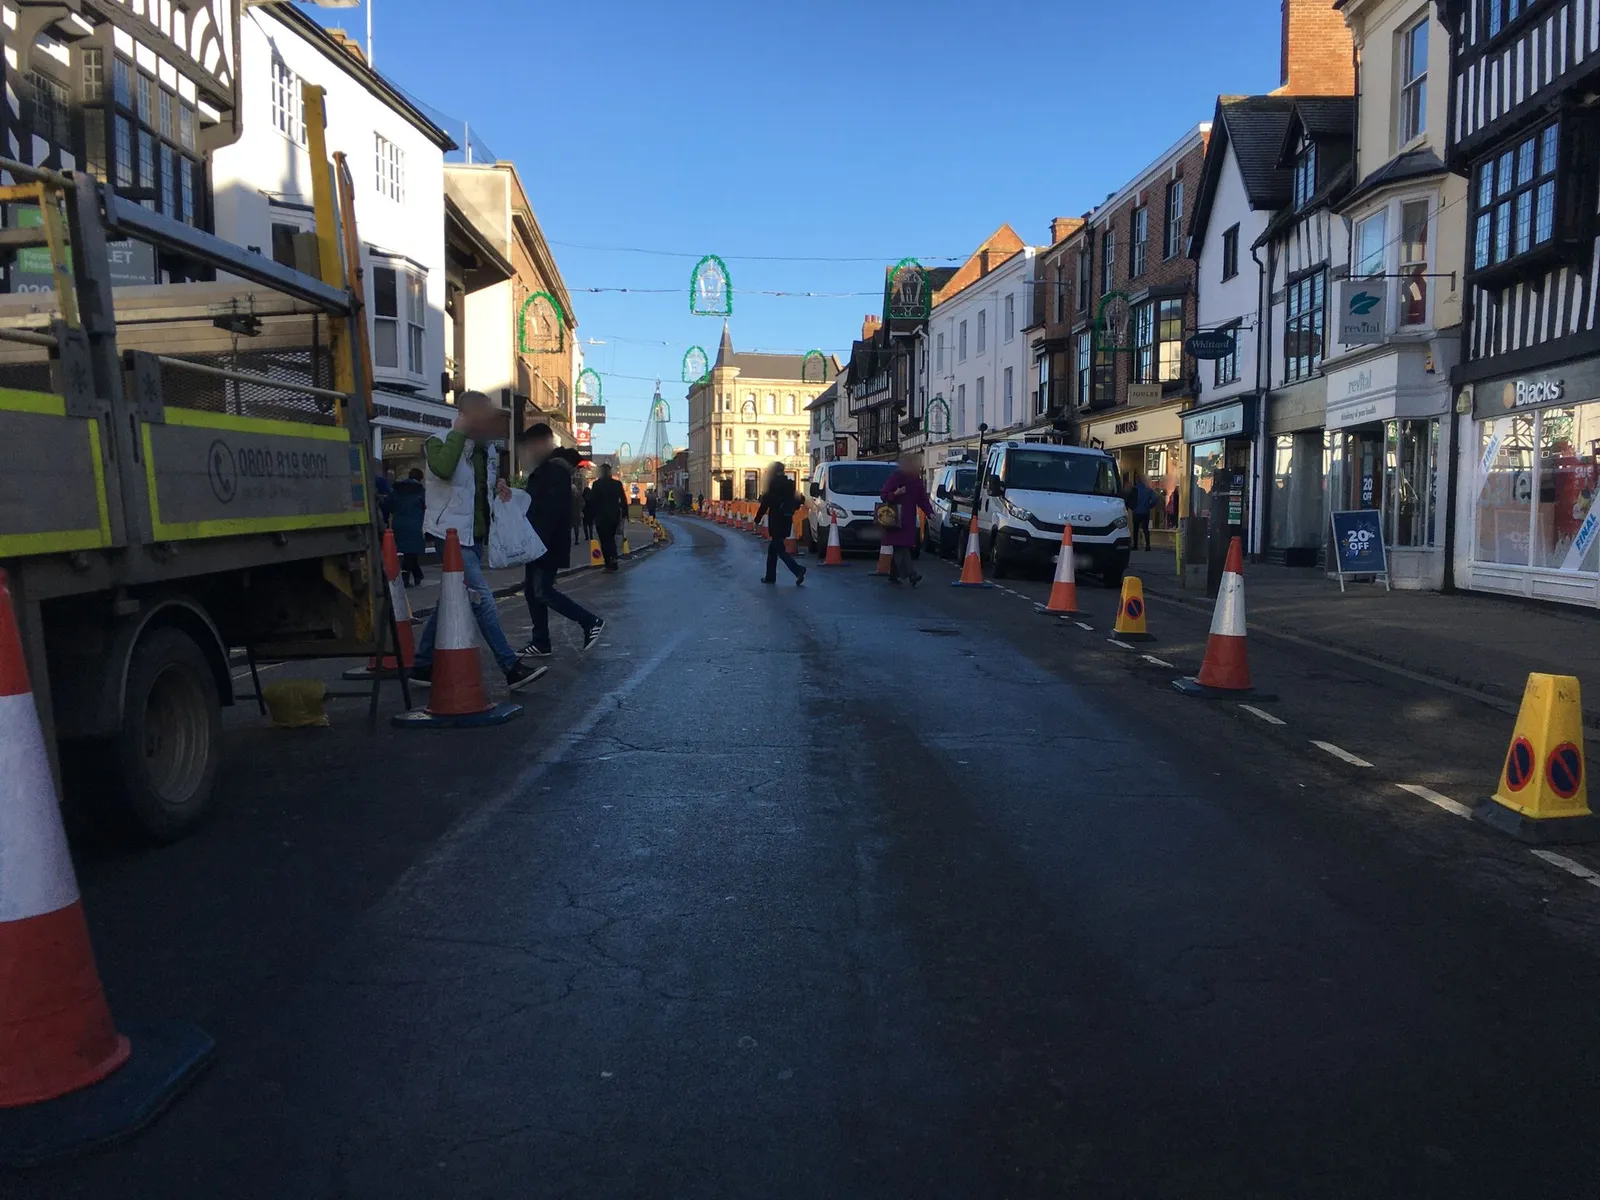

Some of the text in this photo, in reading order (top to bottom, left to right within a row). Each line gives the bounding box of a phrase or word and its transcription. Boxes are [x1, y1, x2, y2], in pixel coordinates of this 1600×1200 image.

[1344, 322, 1380, 333] revital
[1192, 339, 1229, 349] Whittard
[1348, 369, 1372, 394] revital
[1516, 380, 1560, 406] Blacks
[238, 447, 273, 478] 0800
[301, 451, 329, 479] 9001
[1057, 512, 1092, 522] IVECO
[1347, 529, 1375, 542] 20%
[1575, 512, 1597, 551] FINAL
[1349, 542, 1370, 550] OFF
